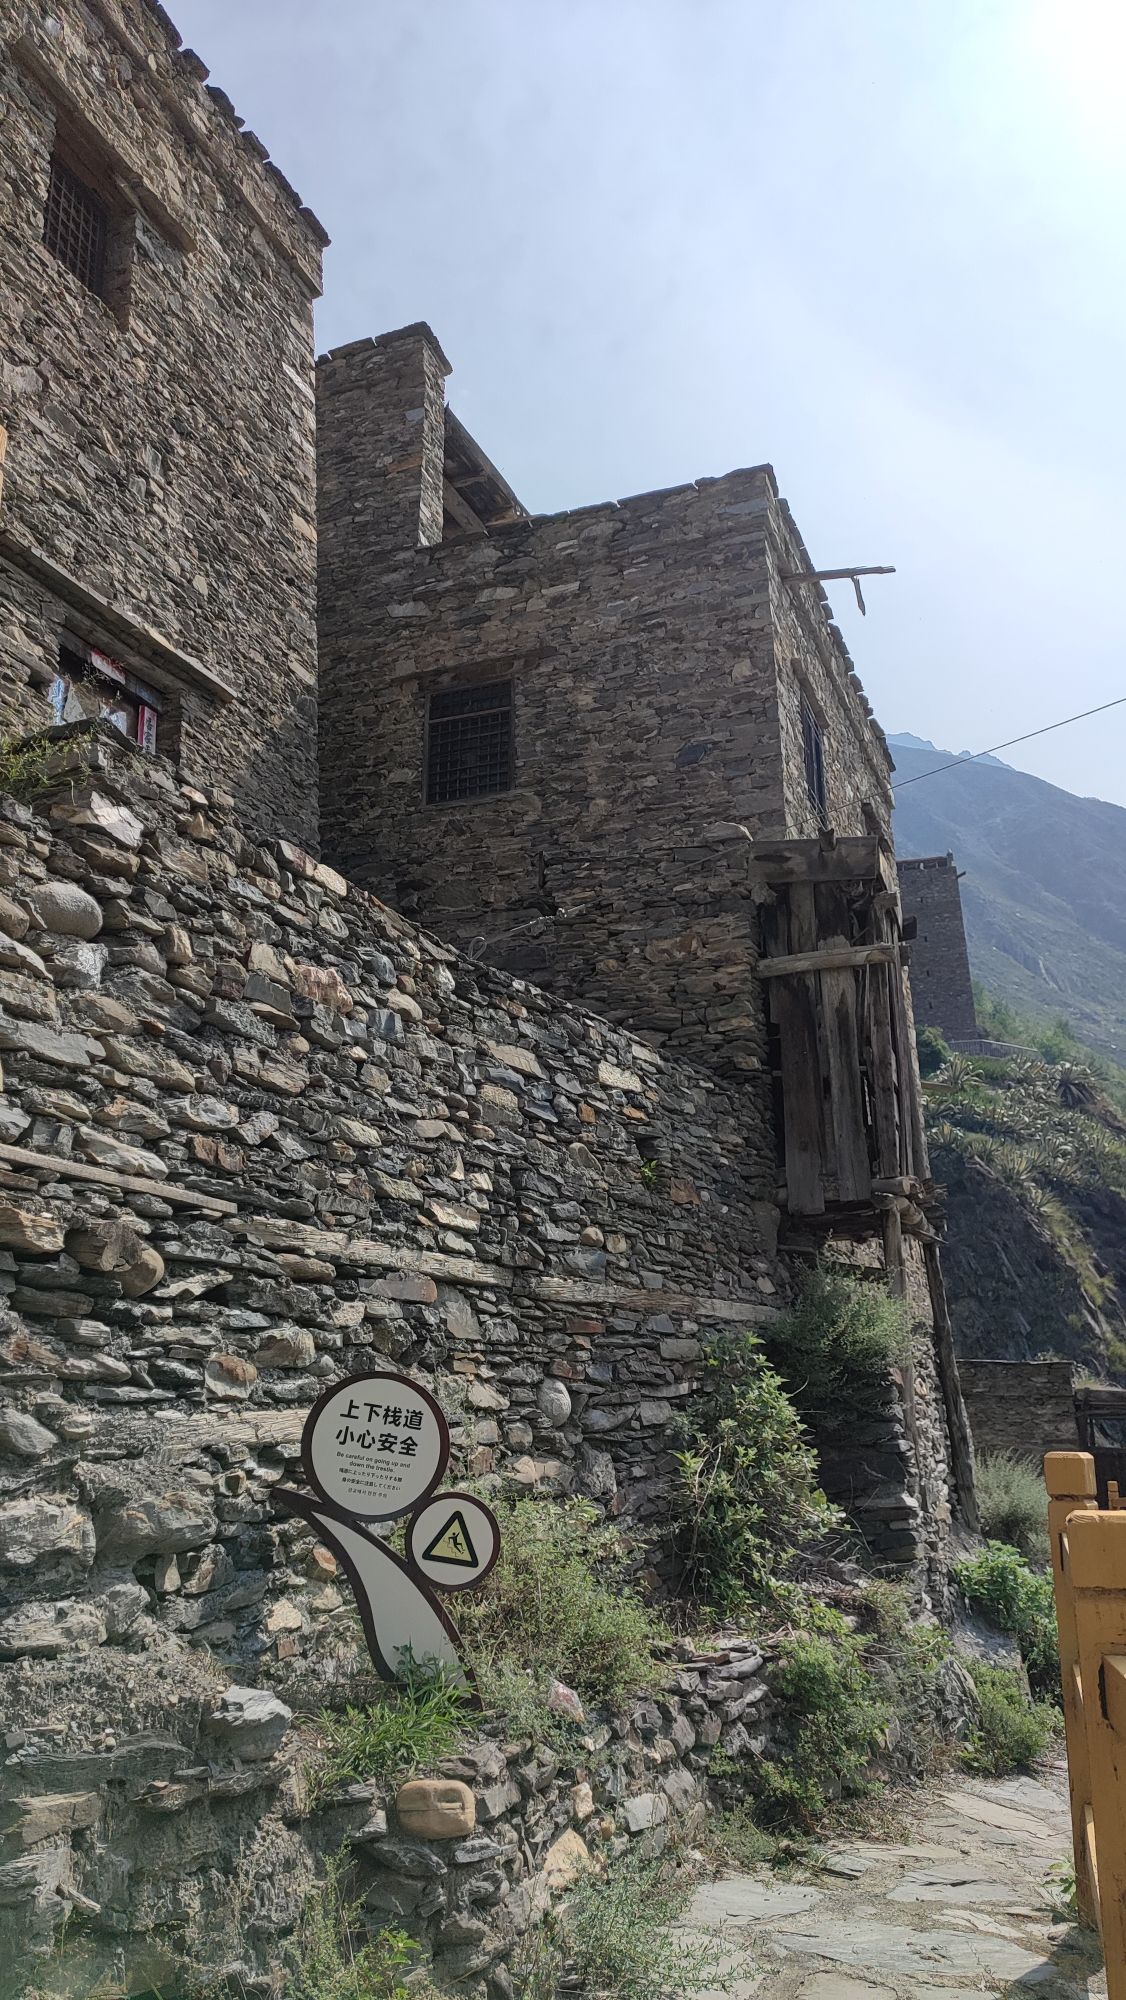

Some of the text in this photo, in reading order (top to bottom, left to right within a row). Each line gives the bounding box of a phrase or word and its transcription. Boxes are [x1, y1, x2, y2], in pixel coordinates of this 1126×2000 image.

[340, 1400, 424, 1430] 上下栈道
[336, 1426, 418, 1456] 小心安全
[374, 1458, 390, 1466] going
